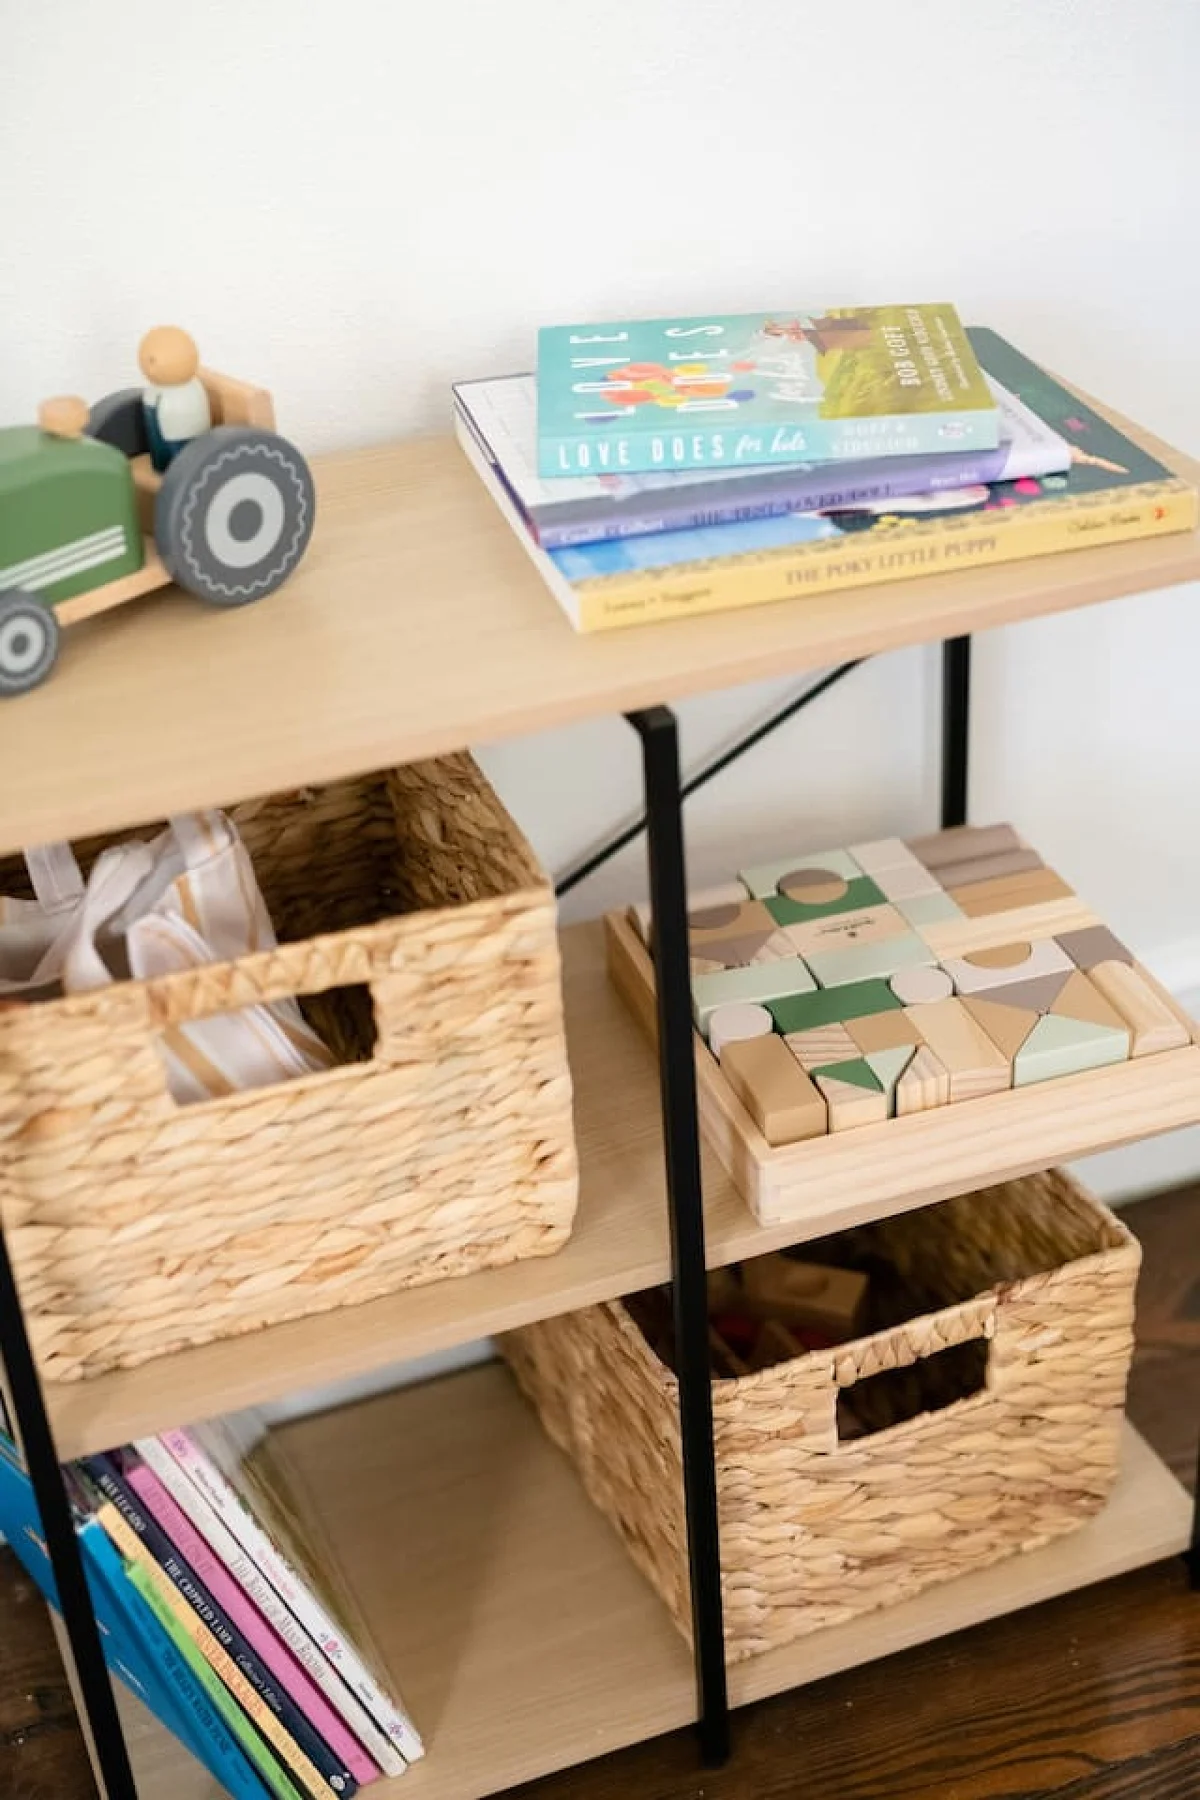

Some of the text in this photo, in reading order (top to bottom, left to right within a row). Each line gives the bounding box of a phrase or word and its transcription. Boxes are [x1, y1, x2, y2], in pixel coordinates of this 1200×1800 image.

[569, 331, 636, 419] LOVE
[664, 325, 739, 413] DOES
[882, 325, 921, 386] BOB GOFF
[558, 440, 631, 469] LOVE
[652, 434, 725, 463] DOES
[785, 568, 820, 586] THE
[879, 546, 936, 570] LITTLE
[162, 1556, 183, 1579] THE
[176, 1575, 217, 1623] CRIPPLED
